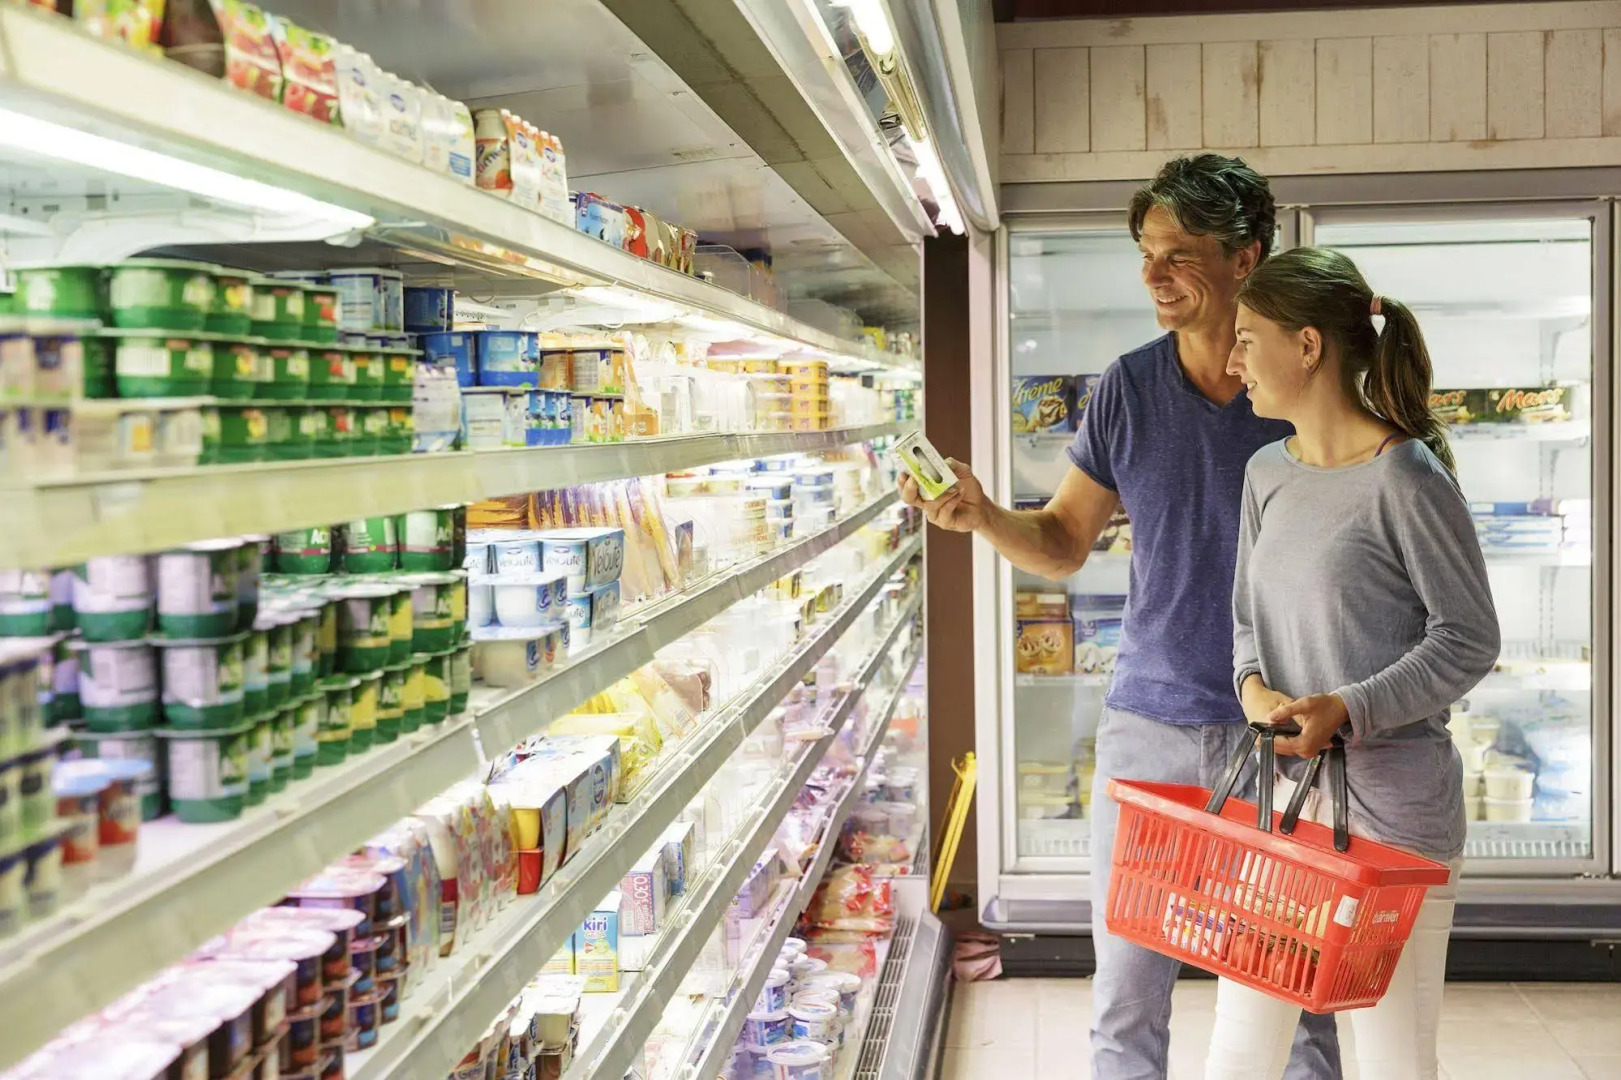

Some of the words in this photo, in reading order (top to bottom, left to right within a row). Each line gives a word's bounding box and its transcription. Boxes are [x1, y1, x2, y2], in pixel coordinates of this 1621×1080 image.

[1429, 390, 1467, 407] ars
[1496, 387, 1564, 413] Mars
[584, 916, 607, 931] kiri
